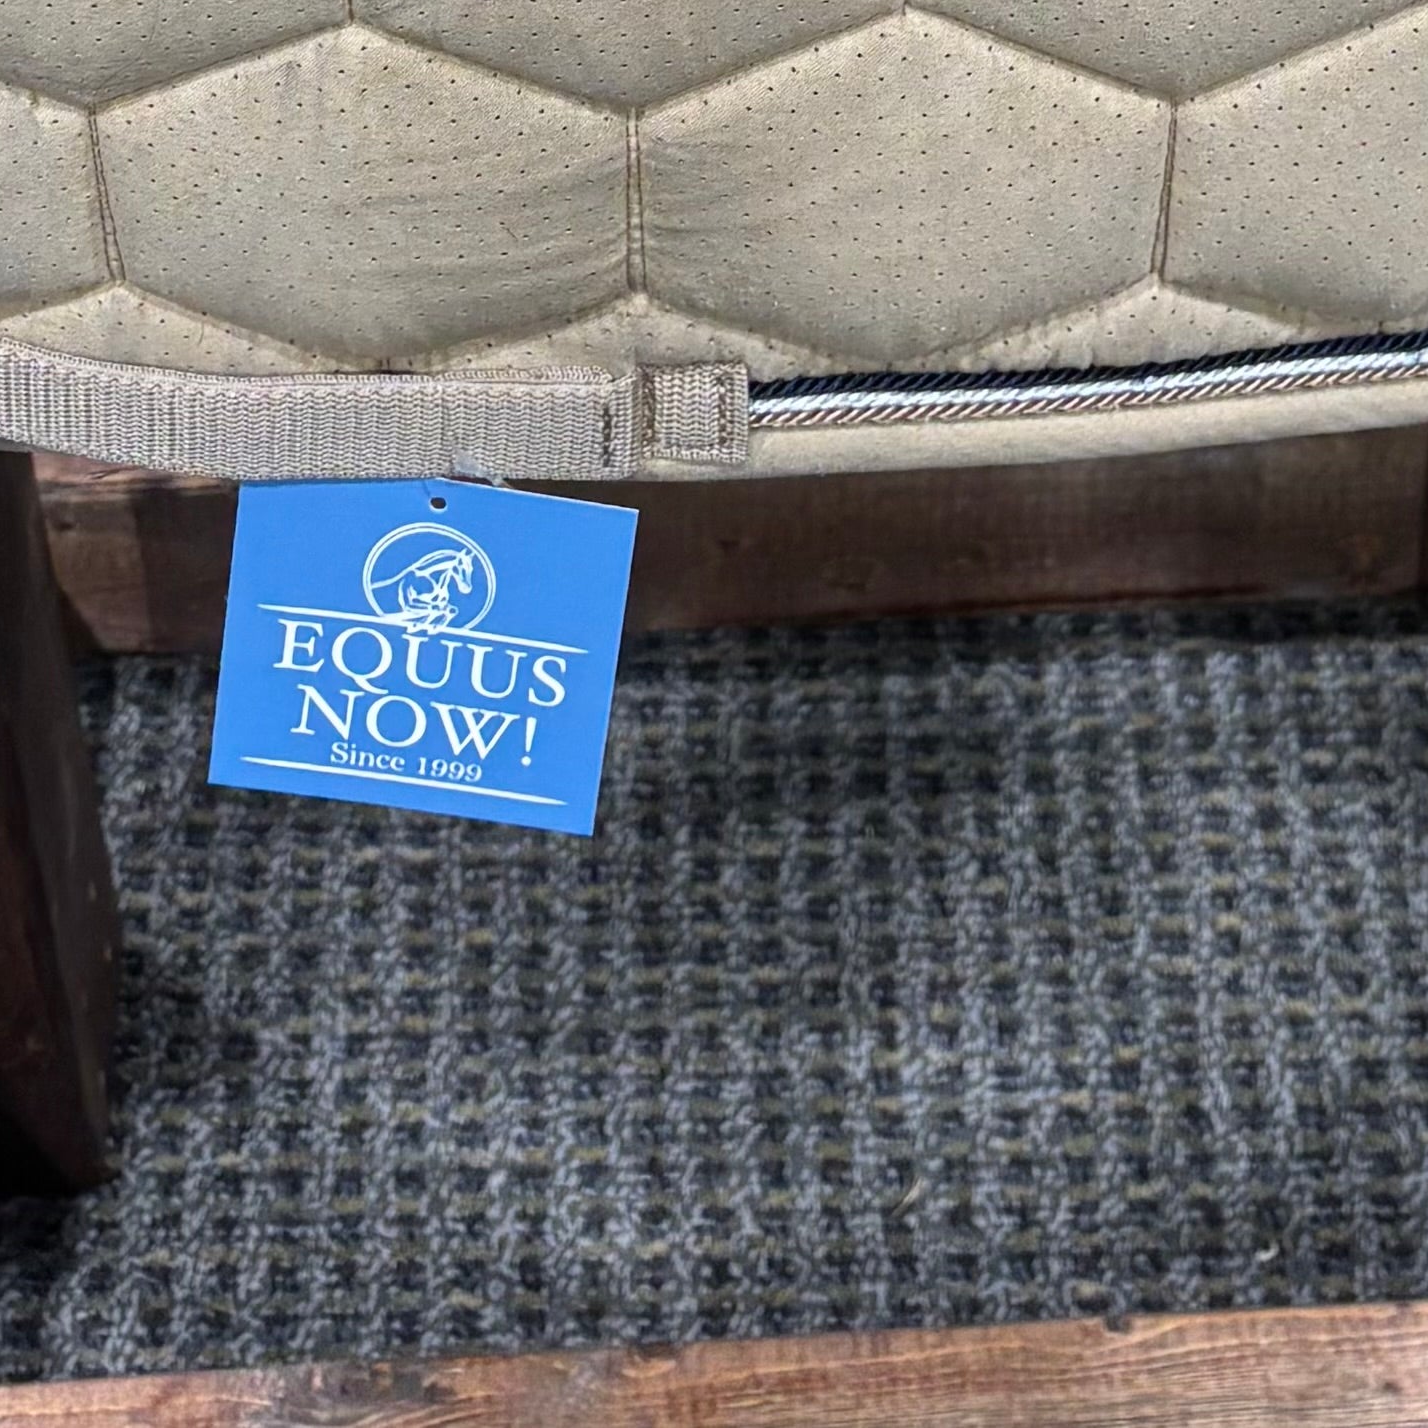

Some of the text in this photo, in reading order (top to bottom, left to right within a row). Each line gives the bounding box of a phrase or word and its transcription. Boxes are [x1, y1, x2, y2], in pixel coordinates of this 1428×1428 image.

[273, 618, 567, 707] EQUUS
[290, 684, 538, 767] NOW!
[329, 742, 483, 783] Since 1999
